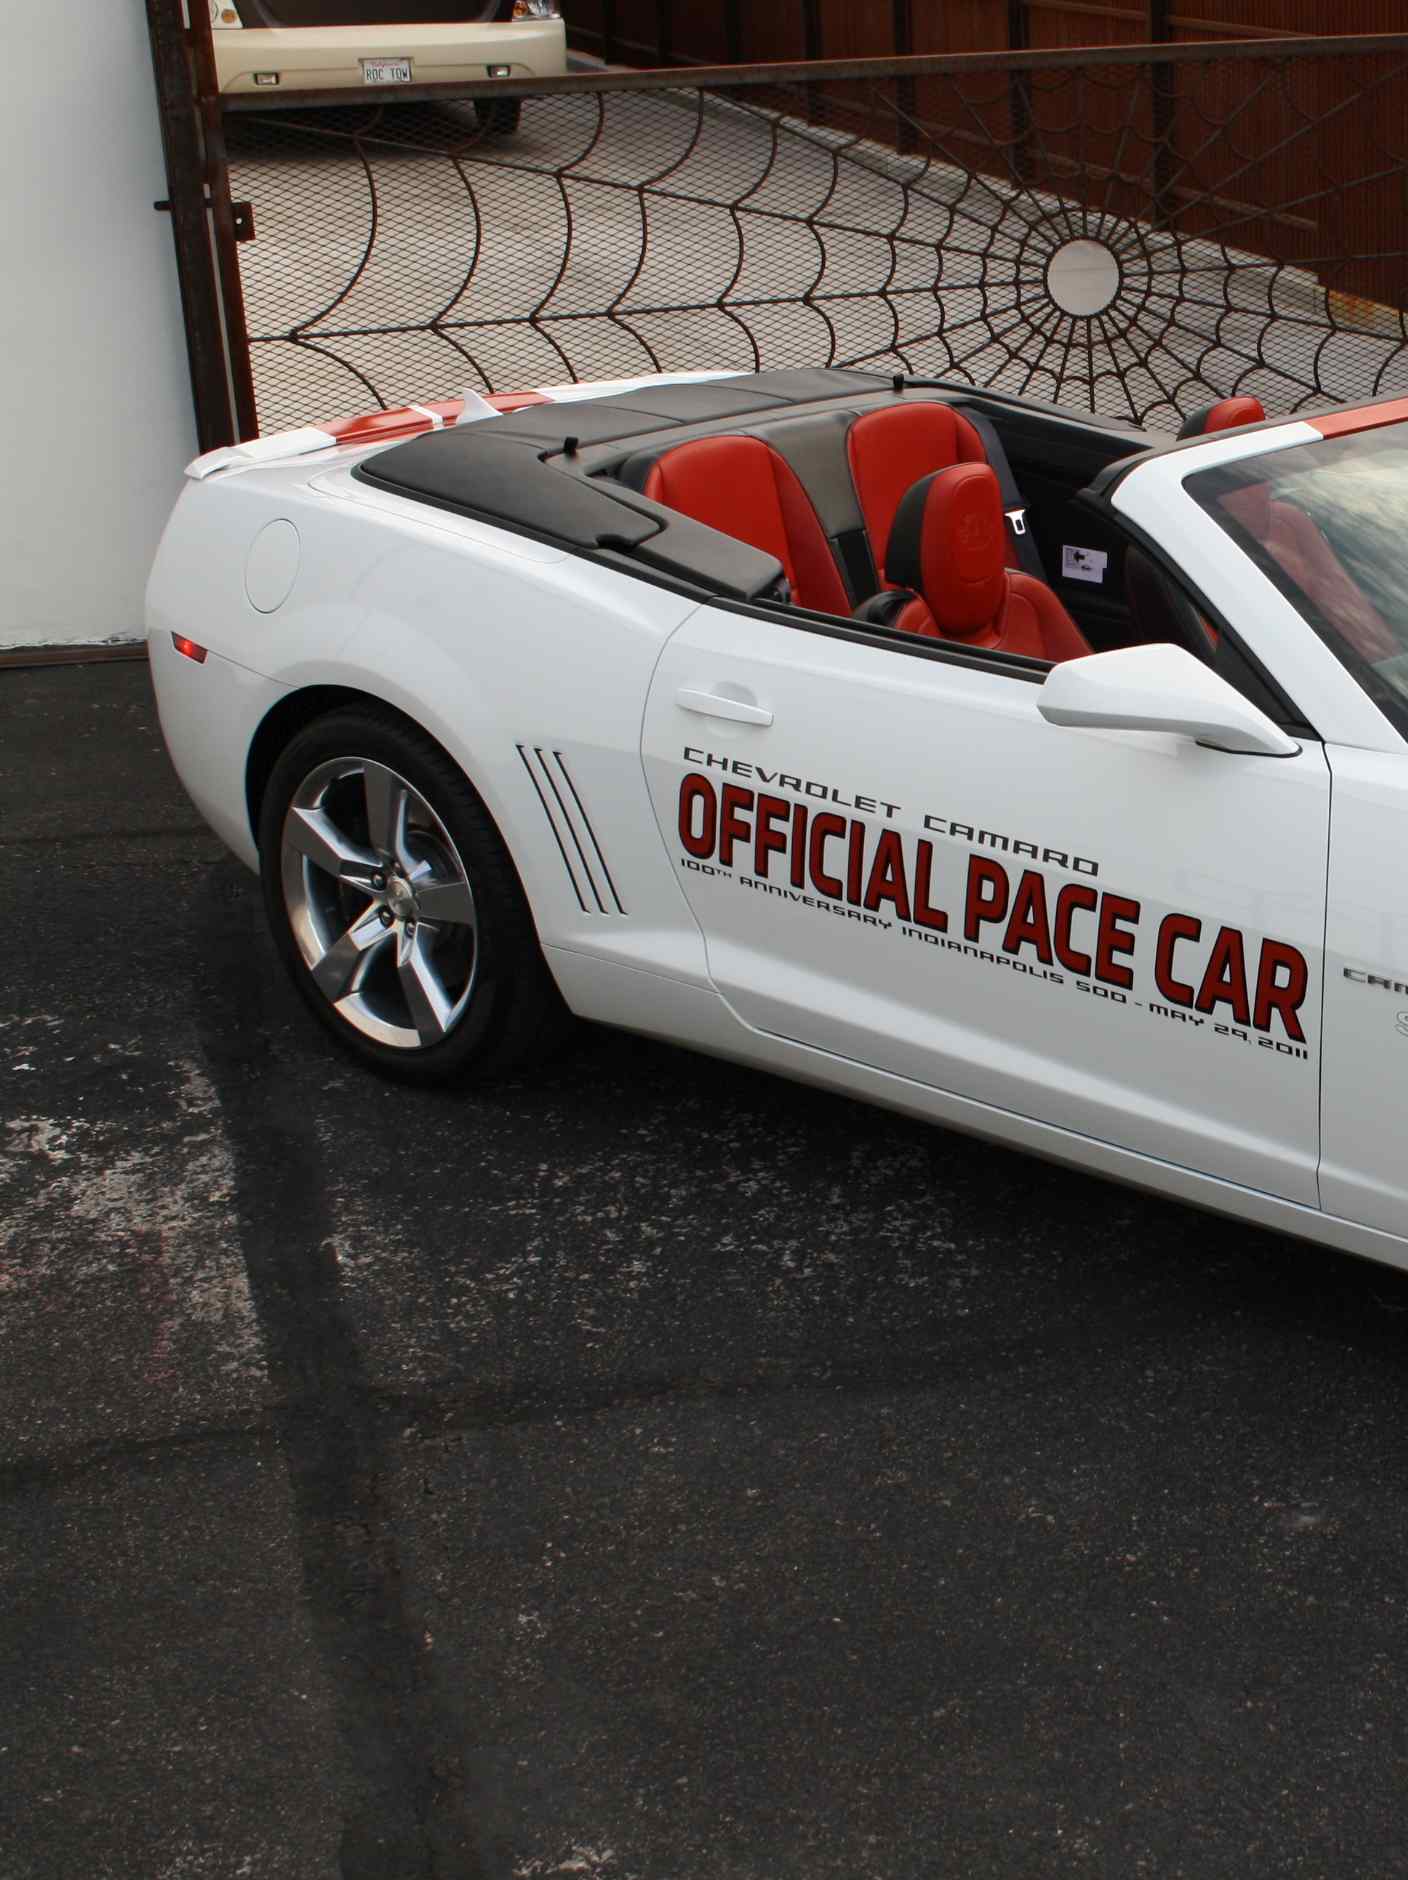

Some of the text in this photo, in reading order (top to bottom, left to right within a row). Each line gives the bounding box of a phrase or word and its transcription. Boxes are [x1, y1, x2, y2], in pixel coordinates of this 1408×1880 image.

[678, 772, 1309, 1044] OFFICIAL PACE CAR
[683, 746, 1099, 877] CHEVROLET CAMARO
[681, 858, 732, 878] 100TH
[740, 876, 893, 929] ANNIVERSARY
[902, 926, 1065, 985] INDIANAPOLIS
[1075, 980, 1128, 1004] 500
[1148, 1002, 1205, 1027] MAY
[1214, 1023, 1252, 1046] 29,
[1258, 1036, 1309, 1061] 2011
